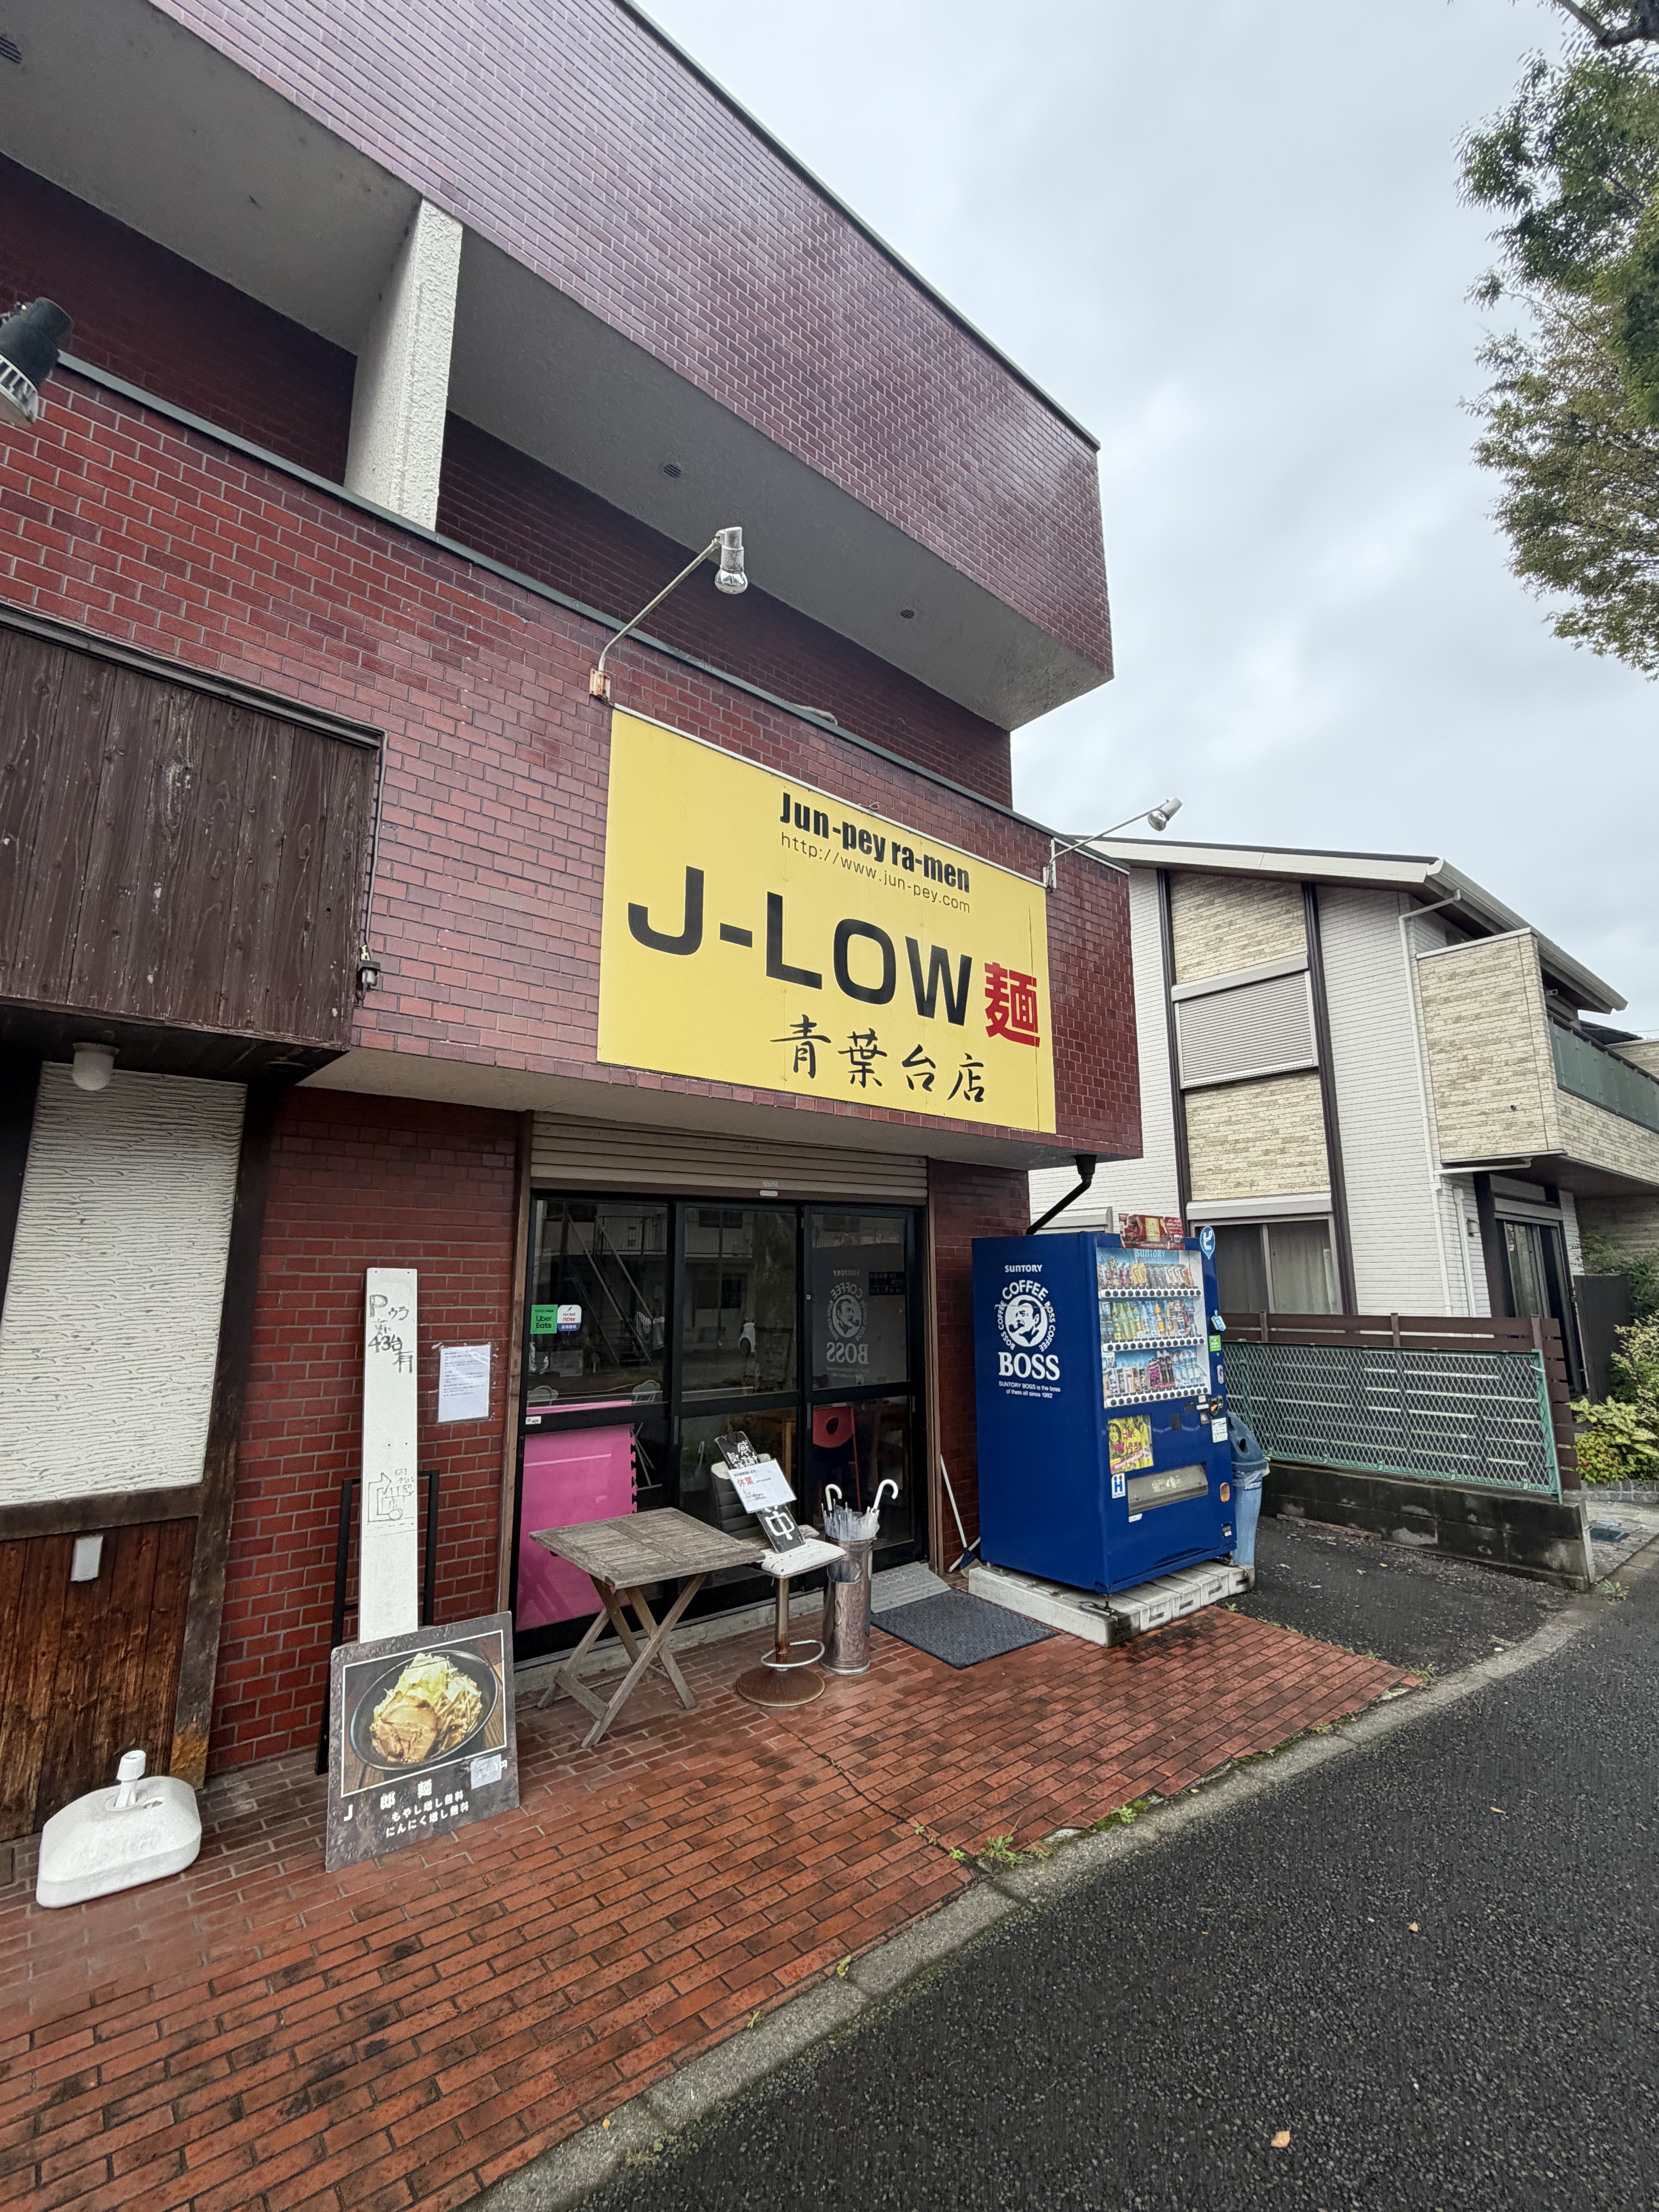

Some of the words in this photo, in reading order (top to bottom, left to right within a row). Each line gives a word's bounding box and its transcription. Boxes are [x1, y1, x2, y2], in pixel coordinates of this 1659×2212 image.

[780, 792, 886, 864] Jun-pey
[891, 841, 970, 894] ra-men
[781, 831, 970, 914] http://www.jun-pey.com
[769, 1014, 985, 1104] 青葉台店
[1136, 1249, 1165, 1258] SUNTORY
[1005, 1264, 1042, 1273] SUNTORY
[1002, 1279, 1048, 1301] COFFEE
[369, 1294, 388, 1317] P
[997, 1300, 1007, 1330] COFFEE
[1044, 1301, 1056, 1323] BOSS
[368, 1334, 403, 1353] 43台
[1001, 1331, 1015, 1350] BOSS
[998, 1352, 1060, 1381] BOSS
[737, 1476, 754, 1487] 休業
[392, 1790, 464, 1822] もやし増し無料
[386, 1801, 469, 1838] にんにく増し無料
